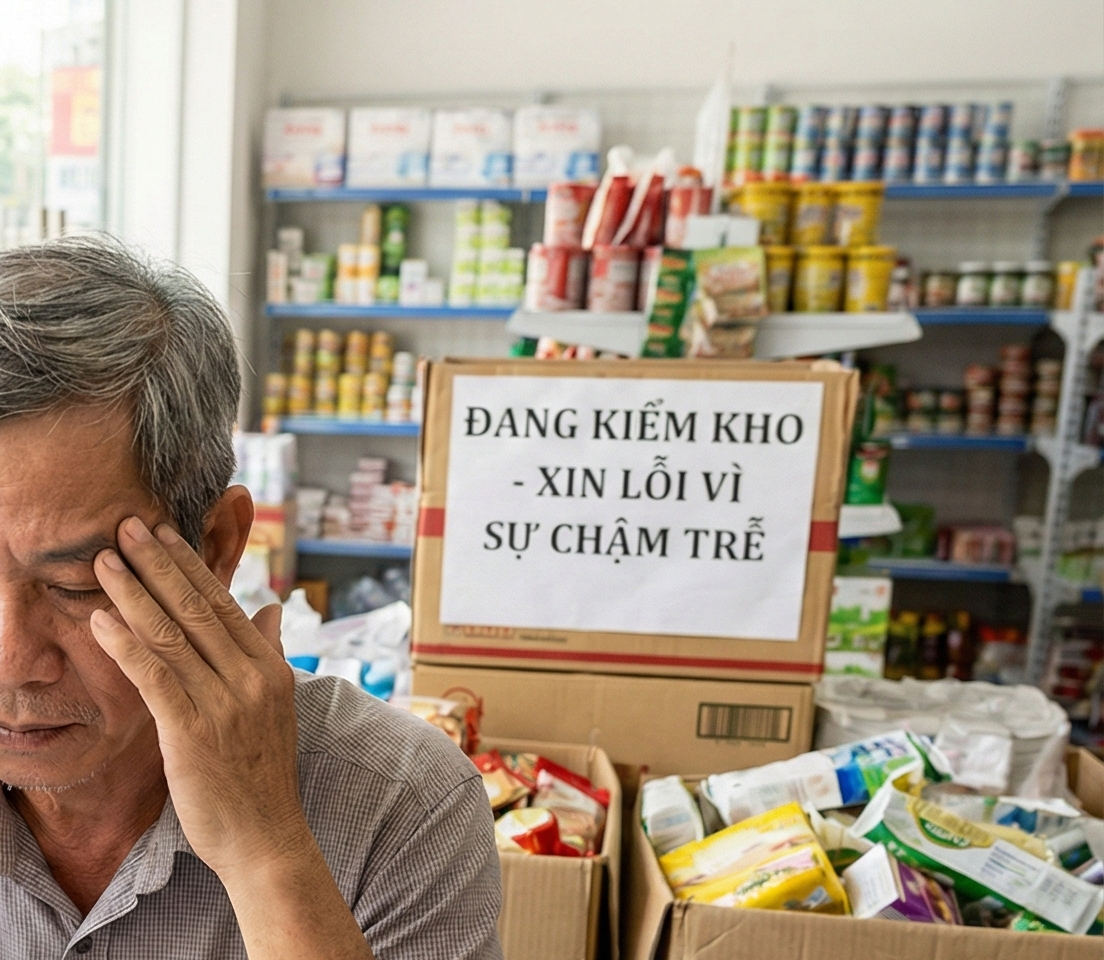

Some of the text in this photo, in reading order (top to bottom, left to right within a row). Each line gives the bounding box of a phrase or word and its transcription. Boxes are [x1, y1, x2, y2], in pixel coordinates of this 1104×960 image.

[464, 398, 804, 445] ĐANG KIỂM KHO
[536, 466, 606, 499] XIN
[620, 455, 688, 502] LỖI
[701, 463, 743, 503] VÌ
[483, 516, 766, 564] SỰ CHẬM TRỄ
